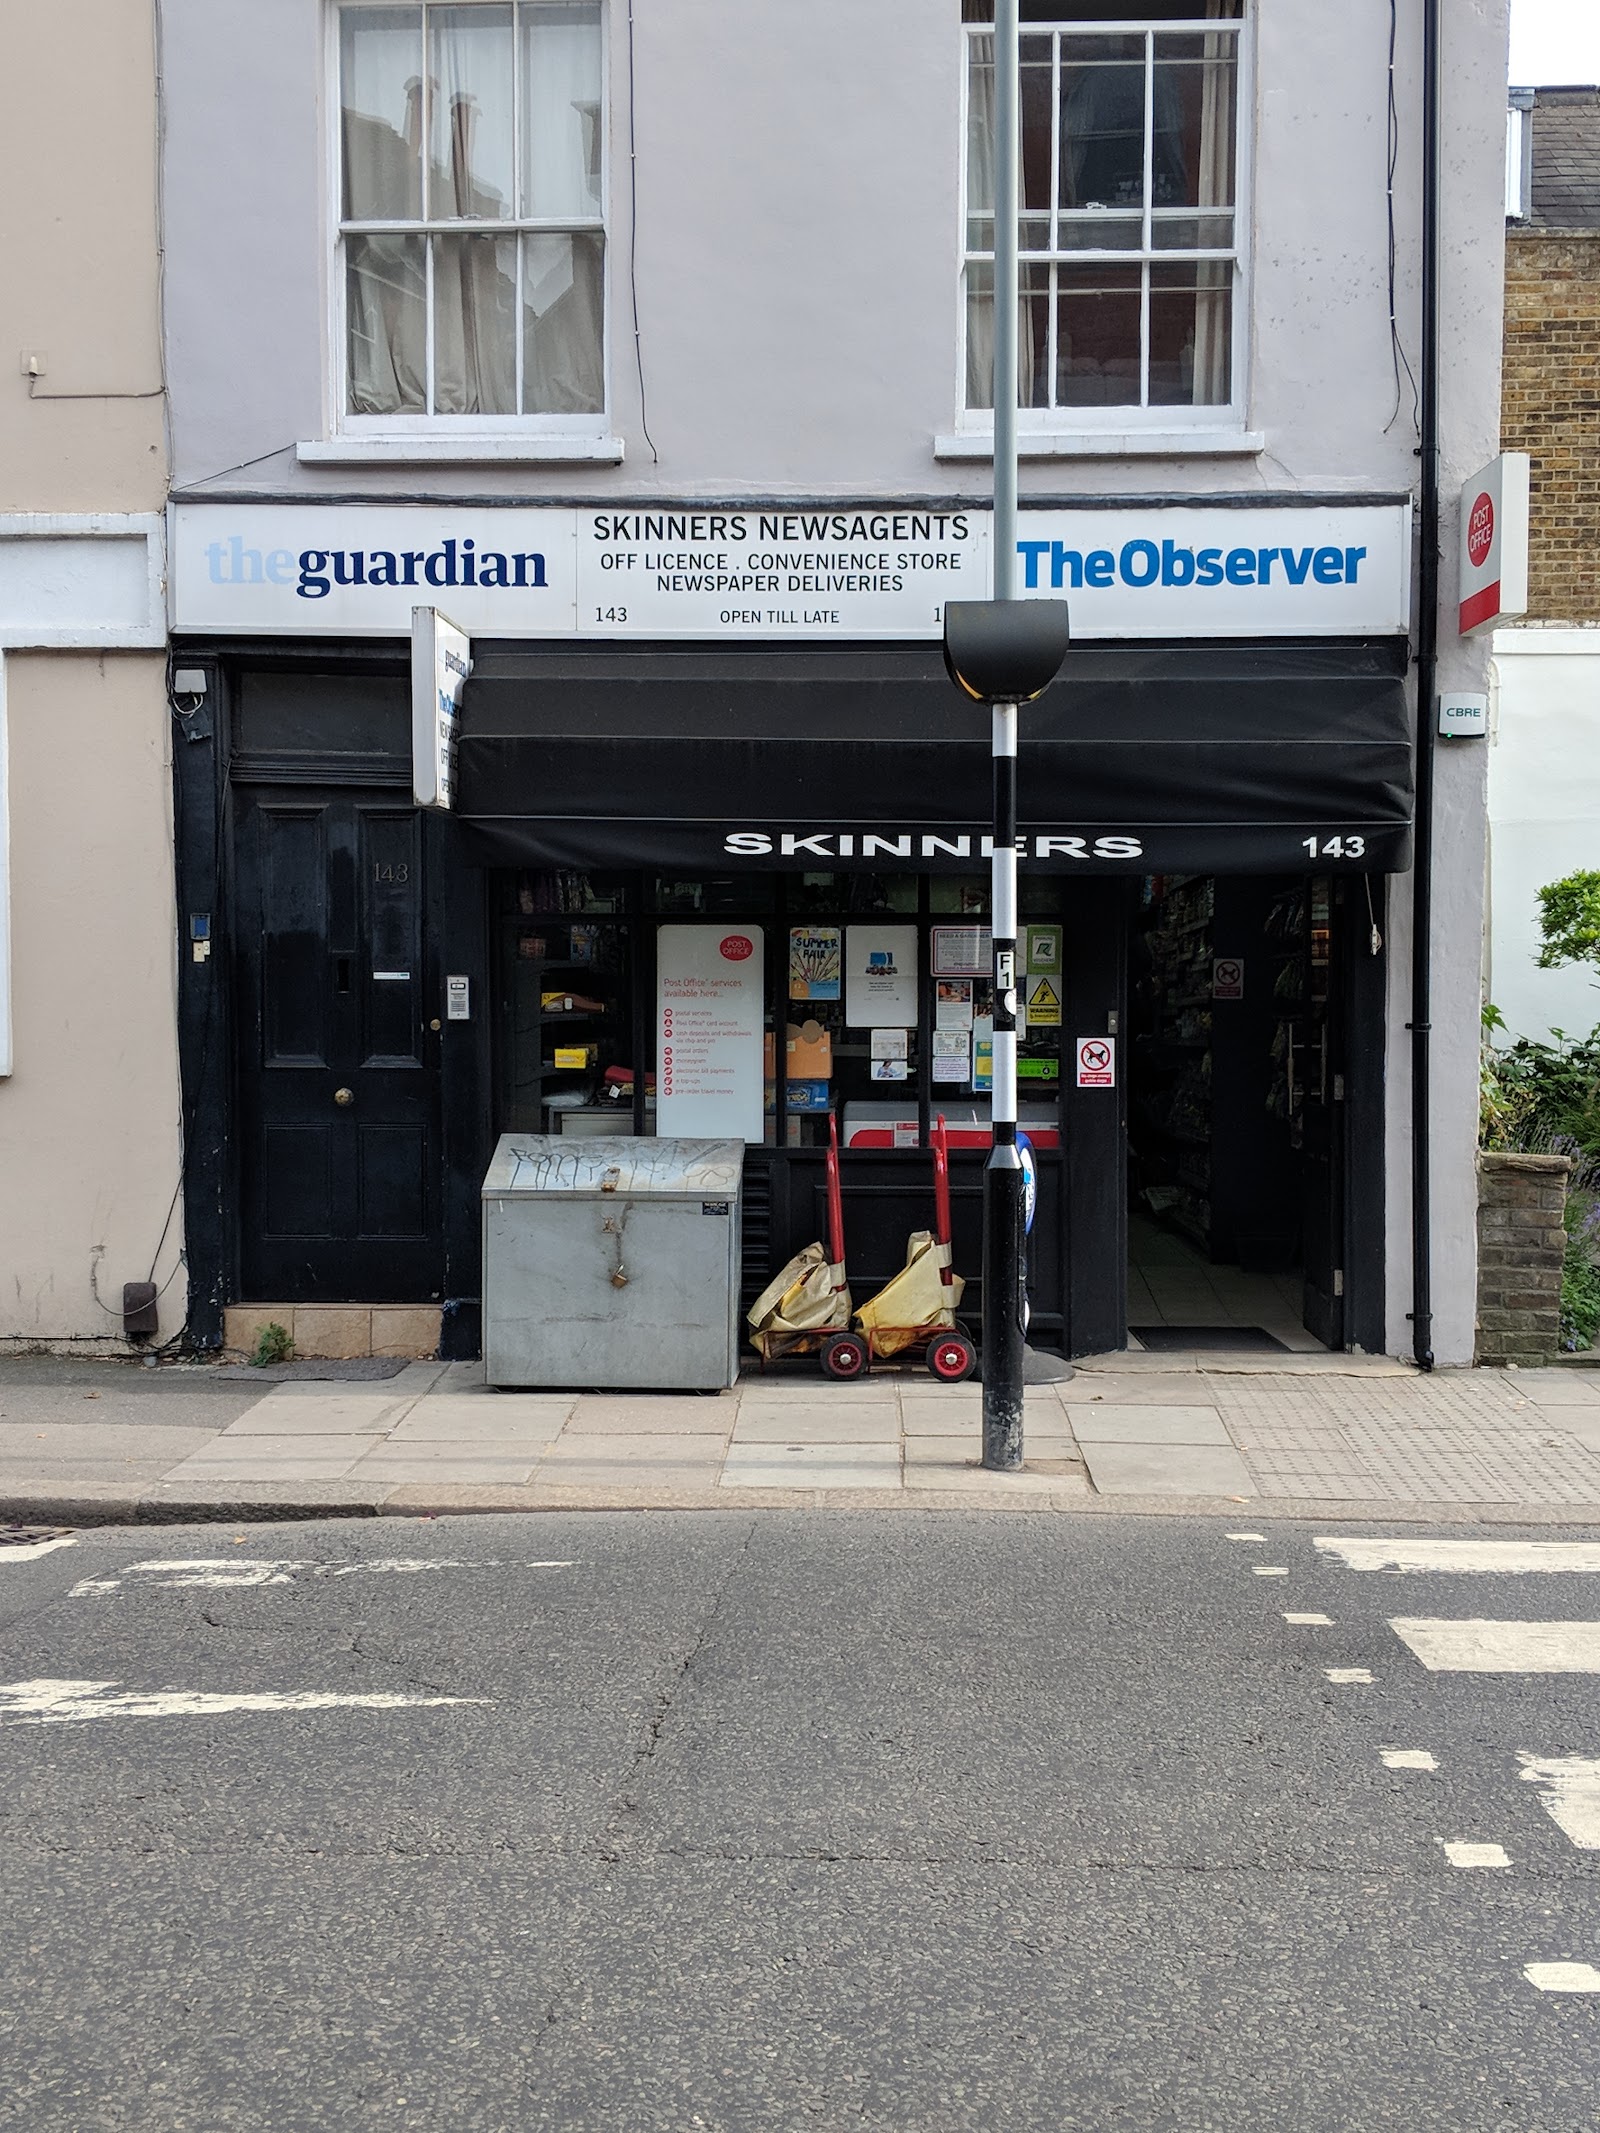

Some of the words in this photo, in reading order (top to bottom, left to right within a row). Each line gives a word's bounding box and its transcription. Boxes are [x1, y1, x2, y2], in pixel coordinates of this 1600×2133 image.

[1473, 504, 1490, 530] POST
[594, 515, 747, 541] SKINNERS
[759, 515, 969, 541] NEWSAGENTS
[1469, 523, 1491, 553] OFFICE
[600, 553, 638, 570] OFF
[645, 553, 728, 570] LICENCE
[748, 553, 890, 570] CONVENIENCE
[897, 553, 961, 570] STORE
[657, 575, 780, 591] NEWSPAPER
[788, 575, 903, 591] DELIVERIES
[595, 607, 627, 622] 143
[720, 610, 761, 623] OPEN
[767, 610, 799, 623] TILL
[803, 610, 840, 623] LATE
[1446, 708, 1481, 717] CBRE
[1301, 836, 1366, 859] 143
[374, 862, 409, 884] 143
[727, 940, 746, 948] POST
[796, 937, 839, 949] SUMMER
[722, 947, 750, 955] OFFICE
[803, 949, 826, 960] FAIR
[1000, 954, 1011, 969] F
[663, 977, 682, 987] Post
[710, 977, 742, 987] services
[1002, 972, 1010, 987] 1
[663, 988, 698, 998] available
